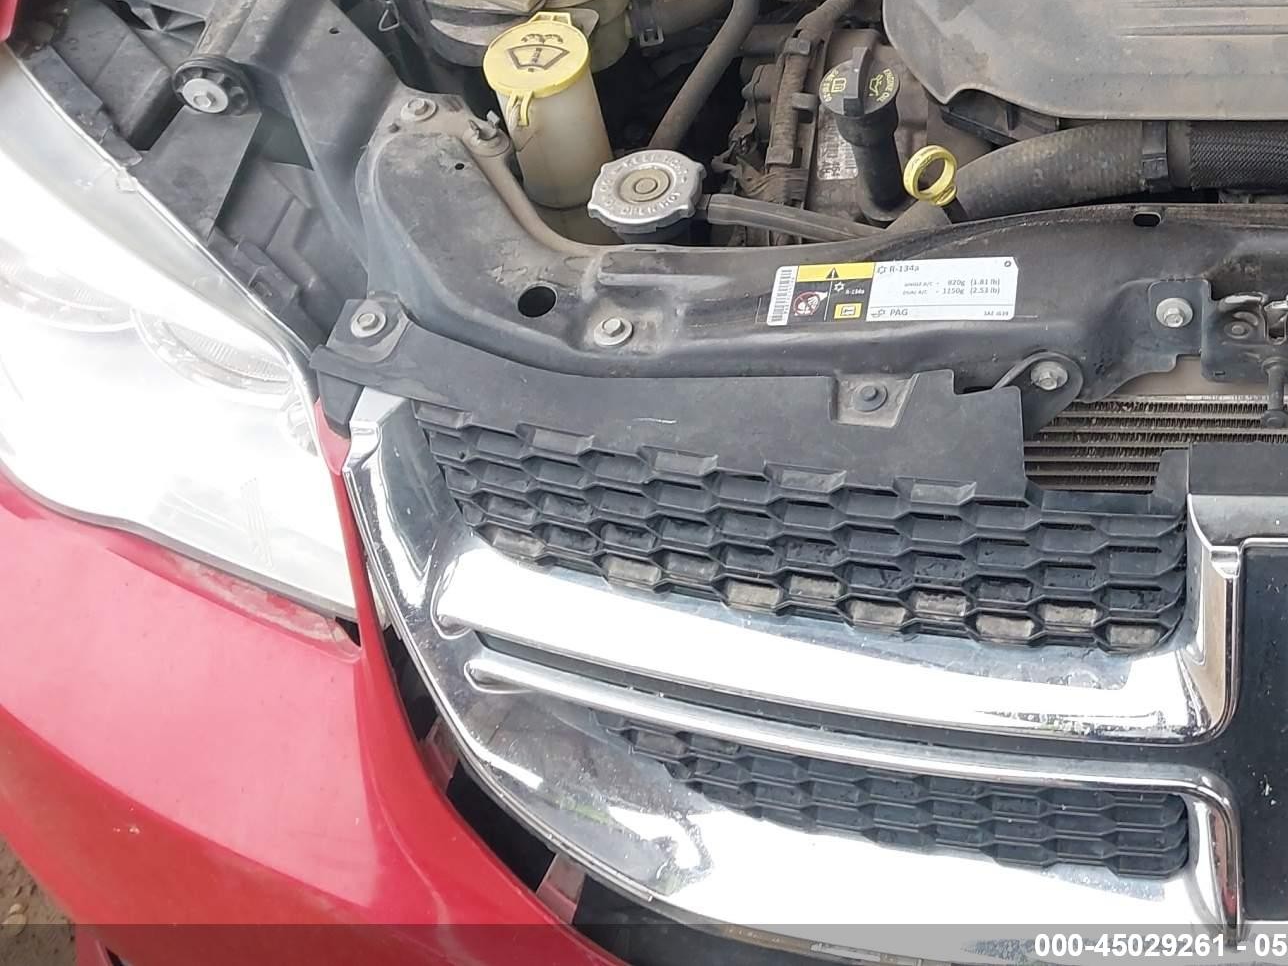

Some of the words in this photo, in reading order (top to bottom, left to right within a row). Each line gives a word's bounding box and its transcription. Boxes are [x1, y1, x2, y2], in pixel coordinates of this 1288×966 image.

[876, 92, 890, 103] OIL
[889, 265, 920, 274] R-134a
[890, 309, 908, 317] PAG
